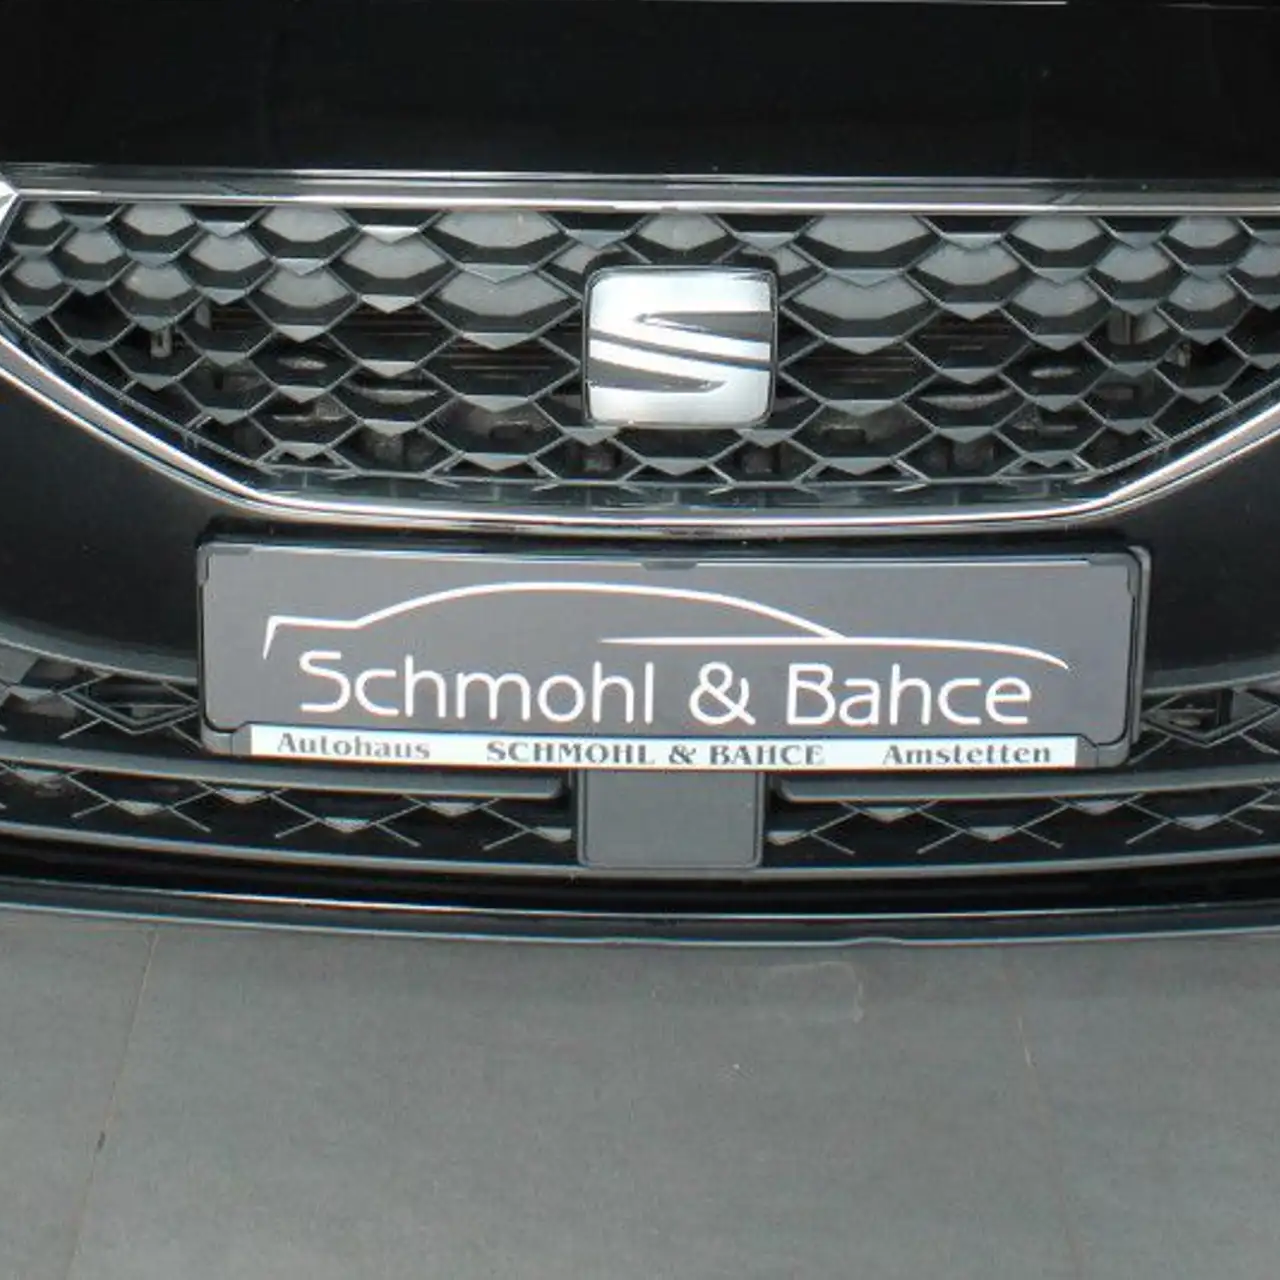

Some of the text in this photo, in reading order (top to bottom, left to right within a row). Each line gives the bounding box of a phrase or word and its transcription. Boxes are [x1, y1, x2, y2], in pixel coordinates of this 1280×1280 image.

[298, 649, 1033, 726] Schmohl & Bahce
[276, 731, 1053, 766] Autohaus SCHMOHL & BAHCE Amstetten
